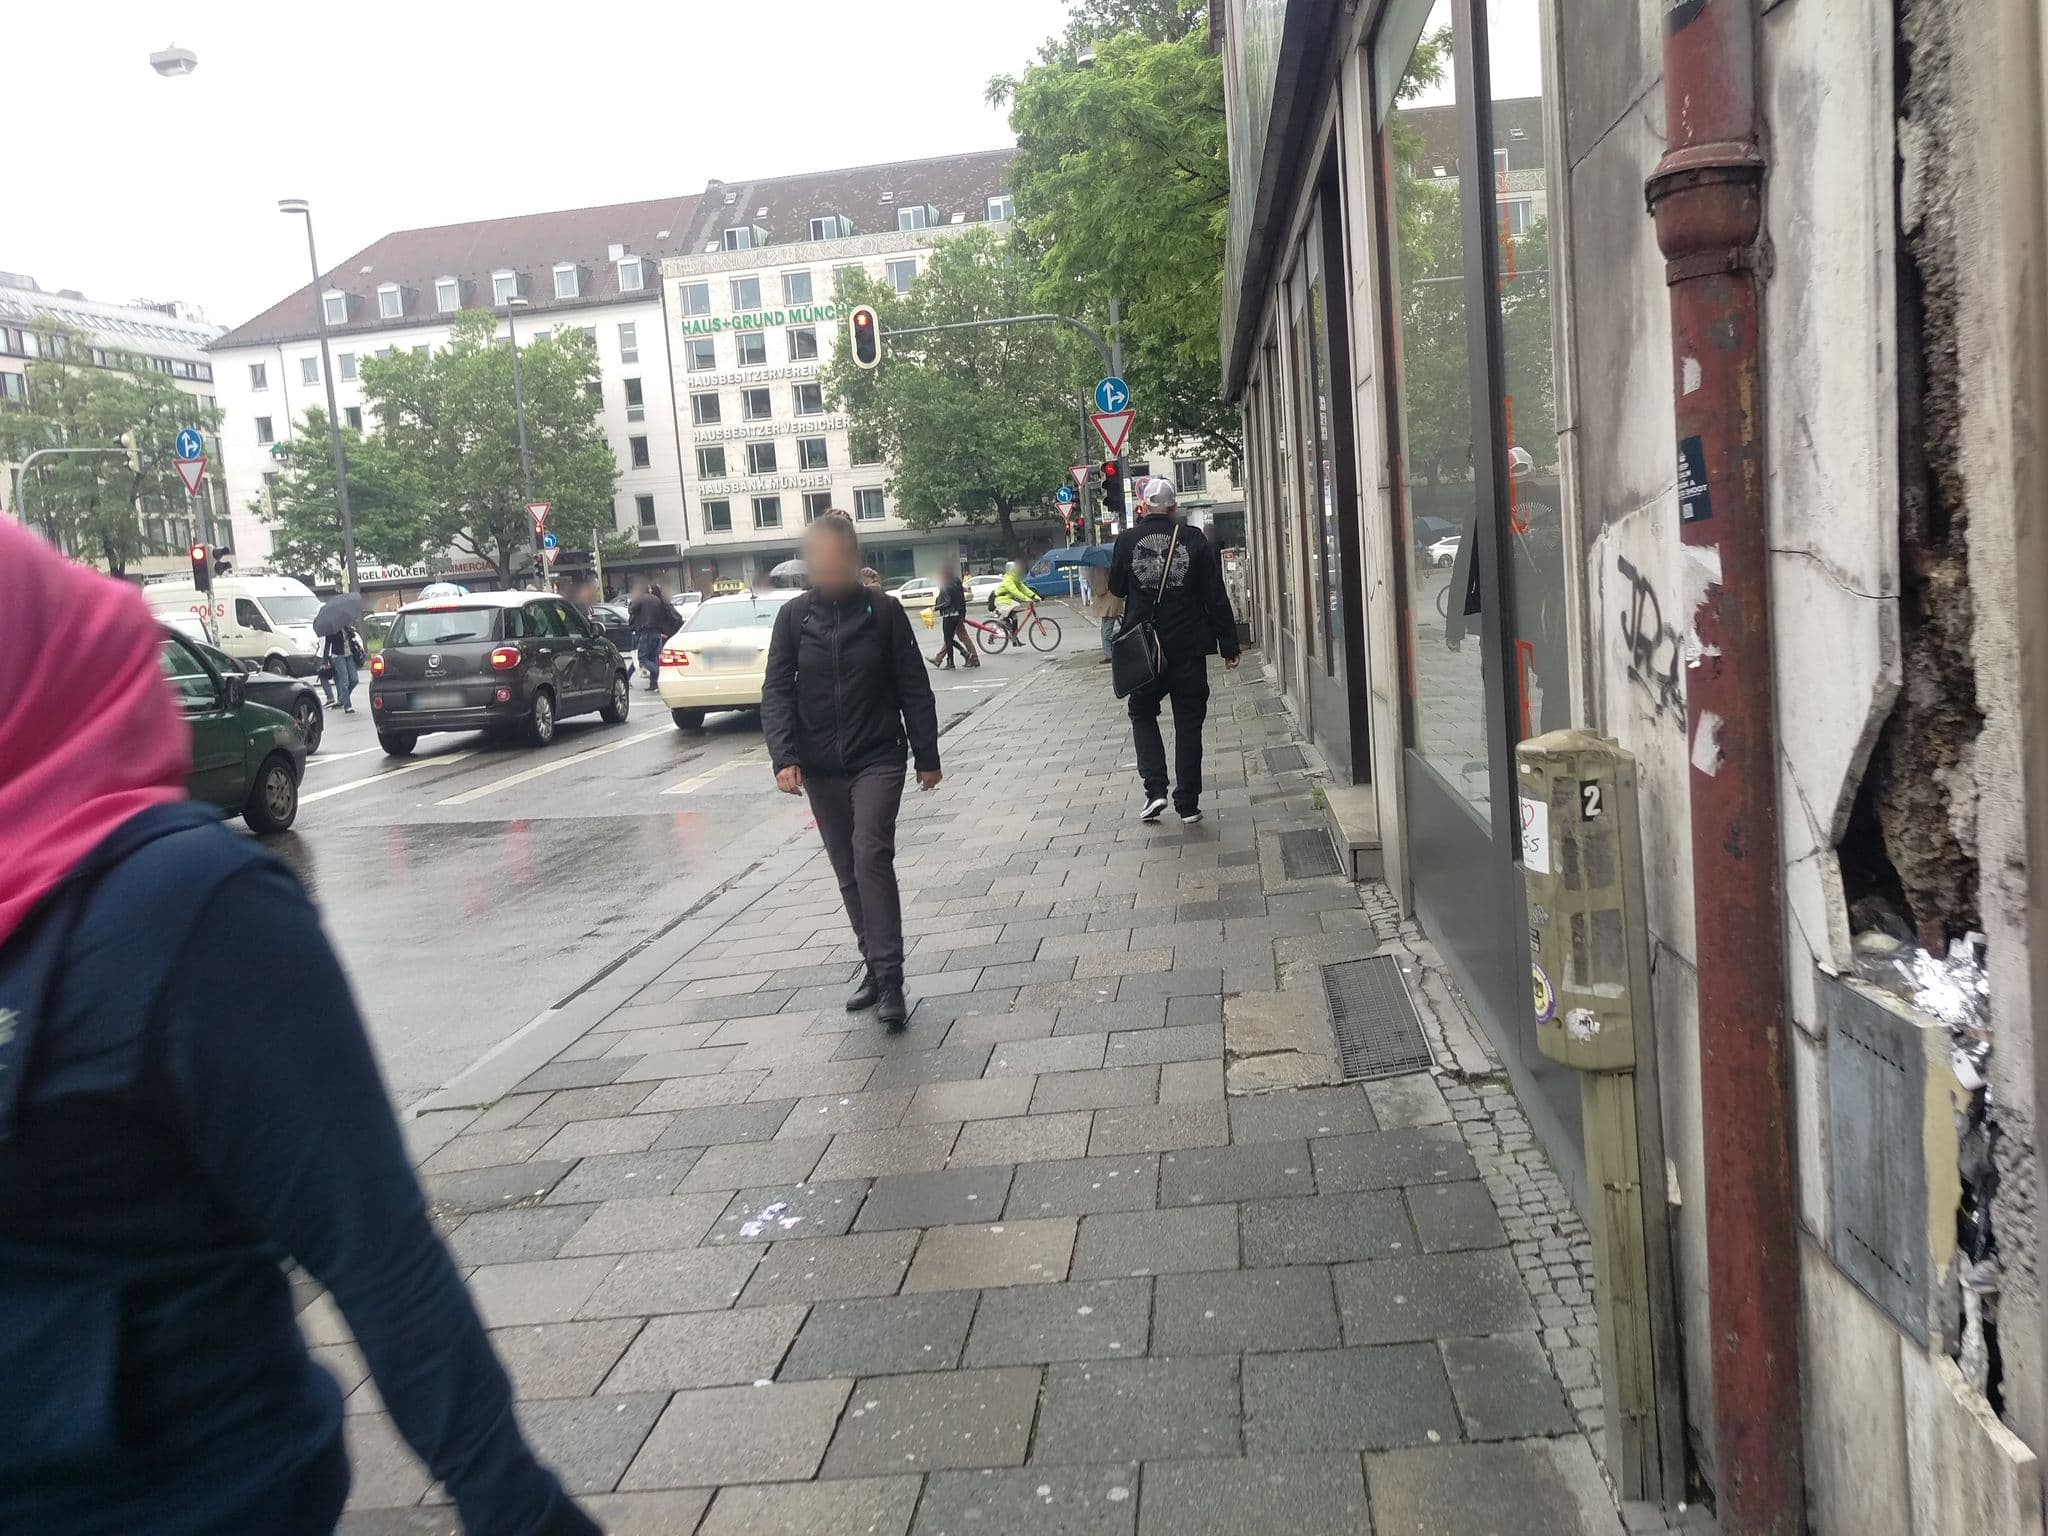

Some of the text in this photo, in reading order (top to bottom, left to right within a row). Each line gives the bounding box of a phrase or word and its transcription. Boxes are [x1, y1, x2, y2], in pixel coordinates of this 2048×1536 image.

[682, 302, 853, 335] HAUS+GRUND MÜNCH
[693, 422, 780, 442] HAUSBESITZER
[697, 477, 766, 496] HAUSBANK
[1584, 785, 1601, 816] 2
